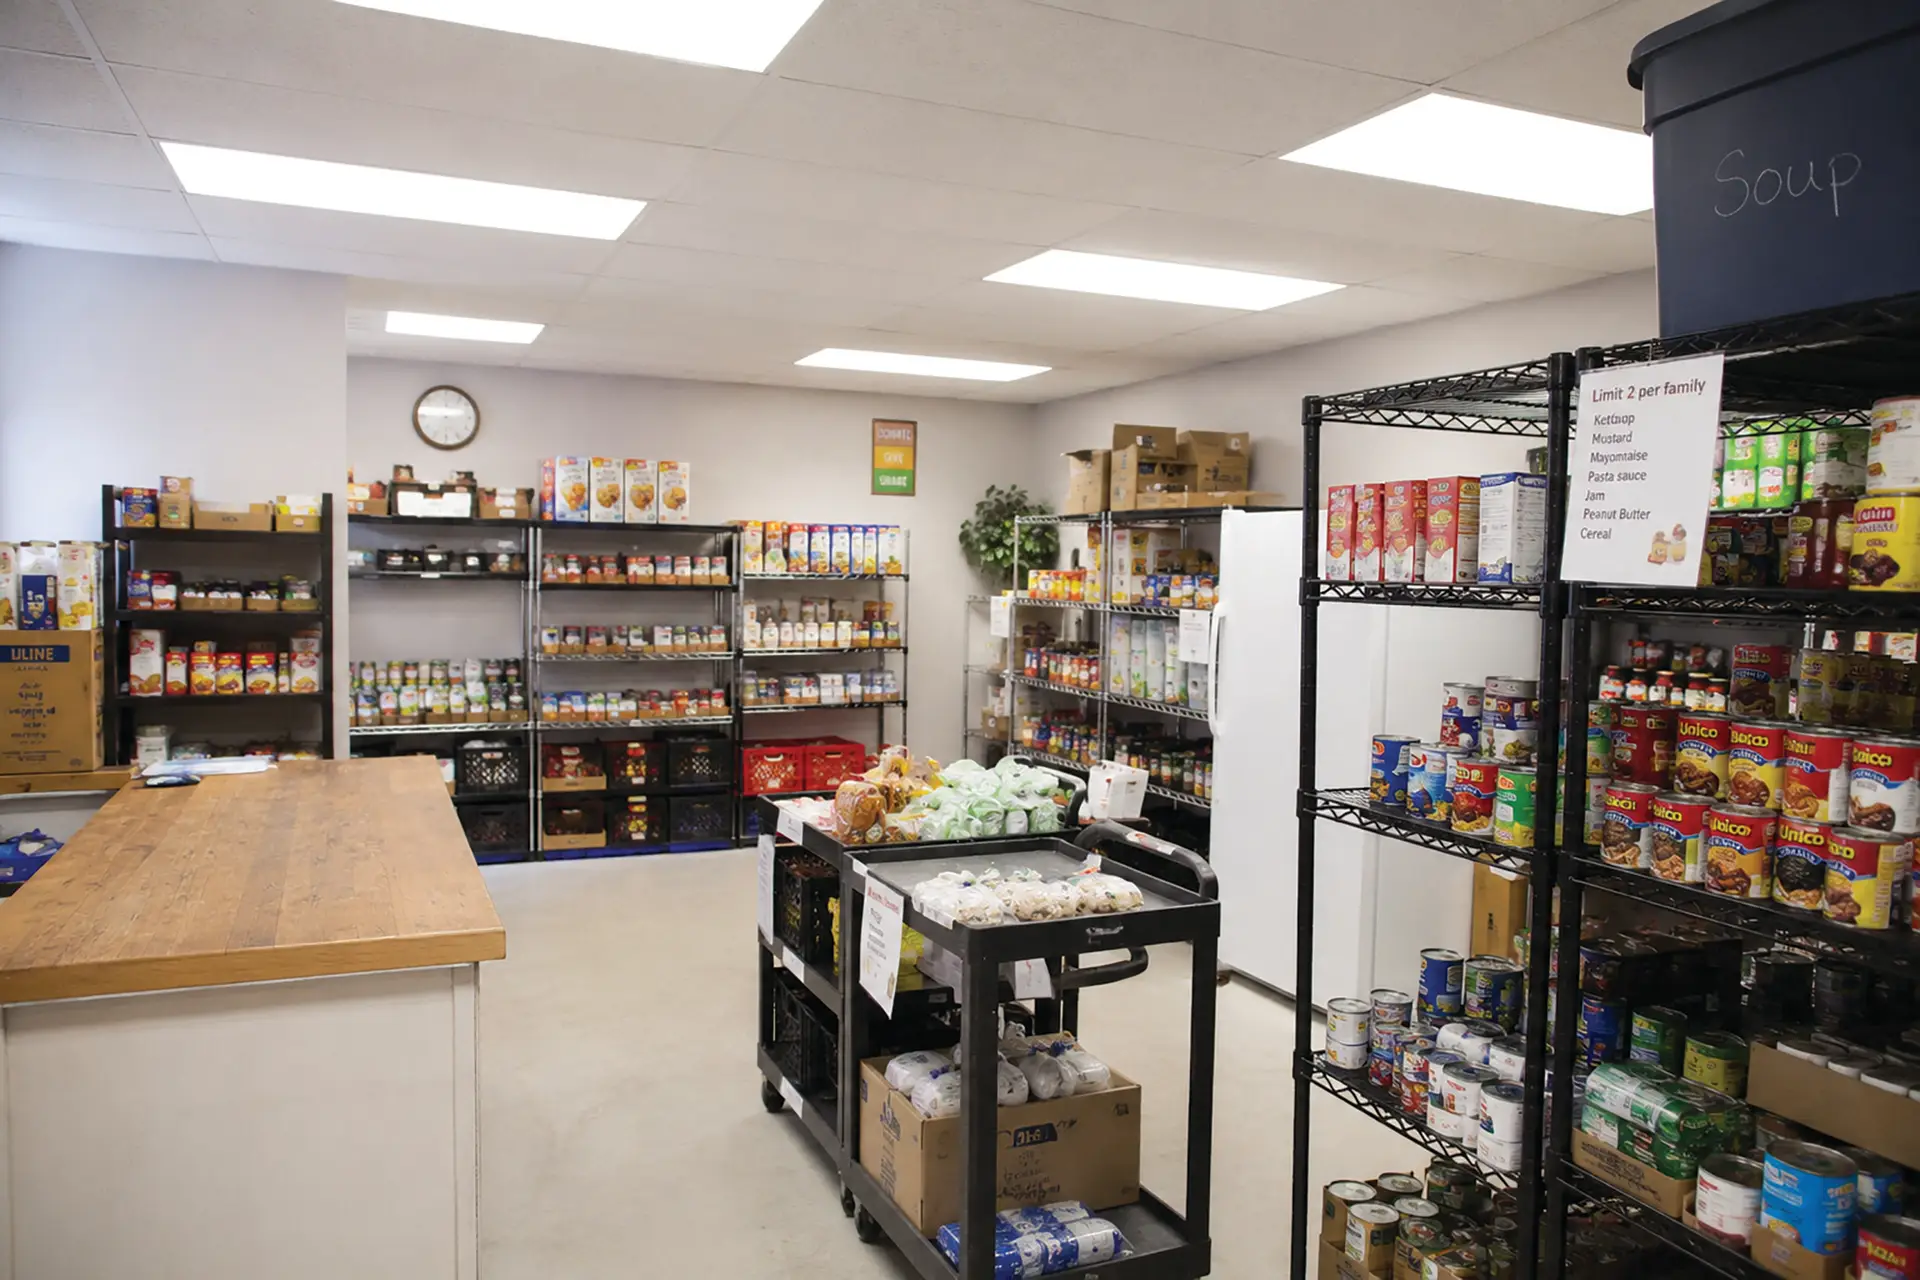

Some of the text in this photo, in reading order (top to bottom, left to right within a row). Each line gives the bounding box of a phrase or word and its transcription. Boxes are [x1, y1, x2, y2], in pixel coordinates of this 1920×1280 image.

[1714, 149, 1862, 218] Soup
[1592, 378, 1706, 402] Limit 2 per family
[1591, 431, 1633, 444] Mustard
[1590, 449, 1648, 465] Mayonnaise
[1588, 470, 1647, 482] Pasta sauce
[1584, 489, 1605, 501] Jam
[1583, 507, 1650, 520] Peanut Butter
[1580, 527, 1612, 539] Cereal
[11, 647, 54, 661] ULINE
[1680, 722, 1718, 738] Unico
[1780, 824, 1825, 846] Unico
